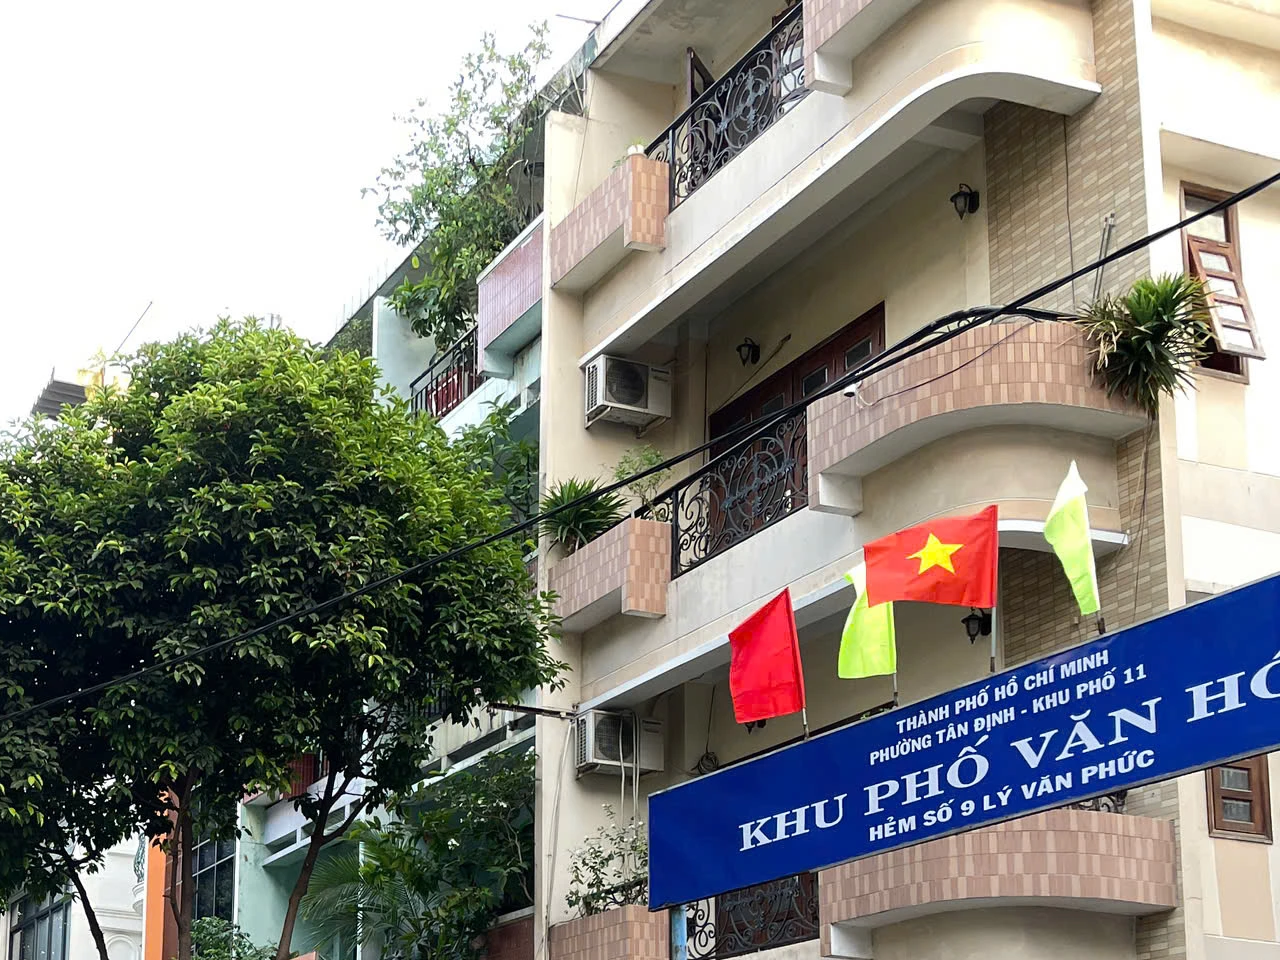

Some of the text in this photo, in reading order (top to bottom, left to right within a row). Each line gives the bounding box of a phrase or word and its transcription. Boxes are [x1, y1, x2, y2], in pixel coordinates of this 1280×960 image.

[869, 734, 932, 766] PHƯỜNG
[935, 721, 969, 744] TÂN
[973, 706, 1015, 732] ĐỊNH
[1032, 688, 1070, 714] KHU
[1076, 666, 1117, 700] PHỐ
[1123, 663, 1147, 684] 11
[896, 649, 1109, 734] THÀNH PHỐ HỒ CHÍ MINH
[738, 793, 848, 852] KHU
[863, 734, 990, 816] PHỐ
[1010, 697, 1162, 769] VĂN
[869, 749, 1156, 842] HẺM SỐ 9 LÝ VĂN PHỨC
